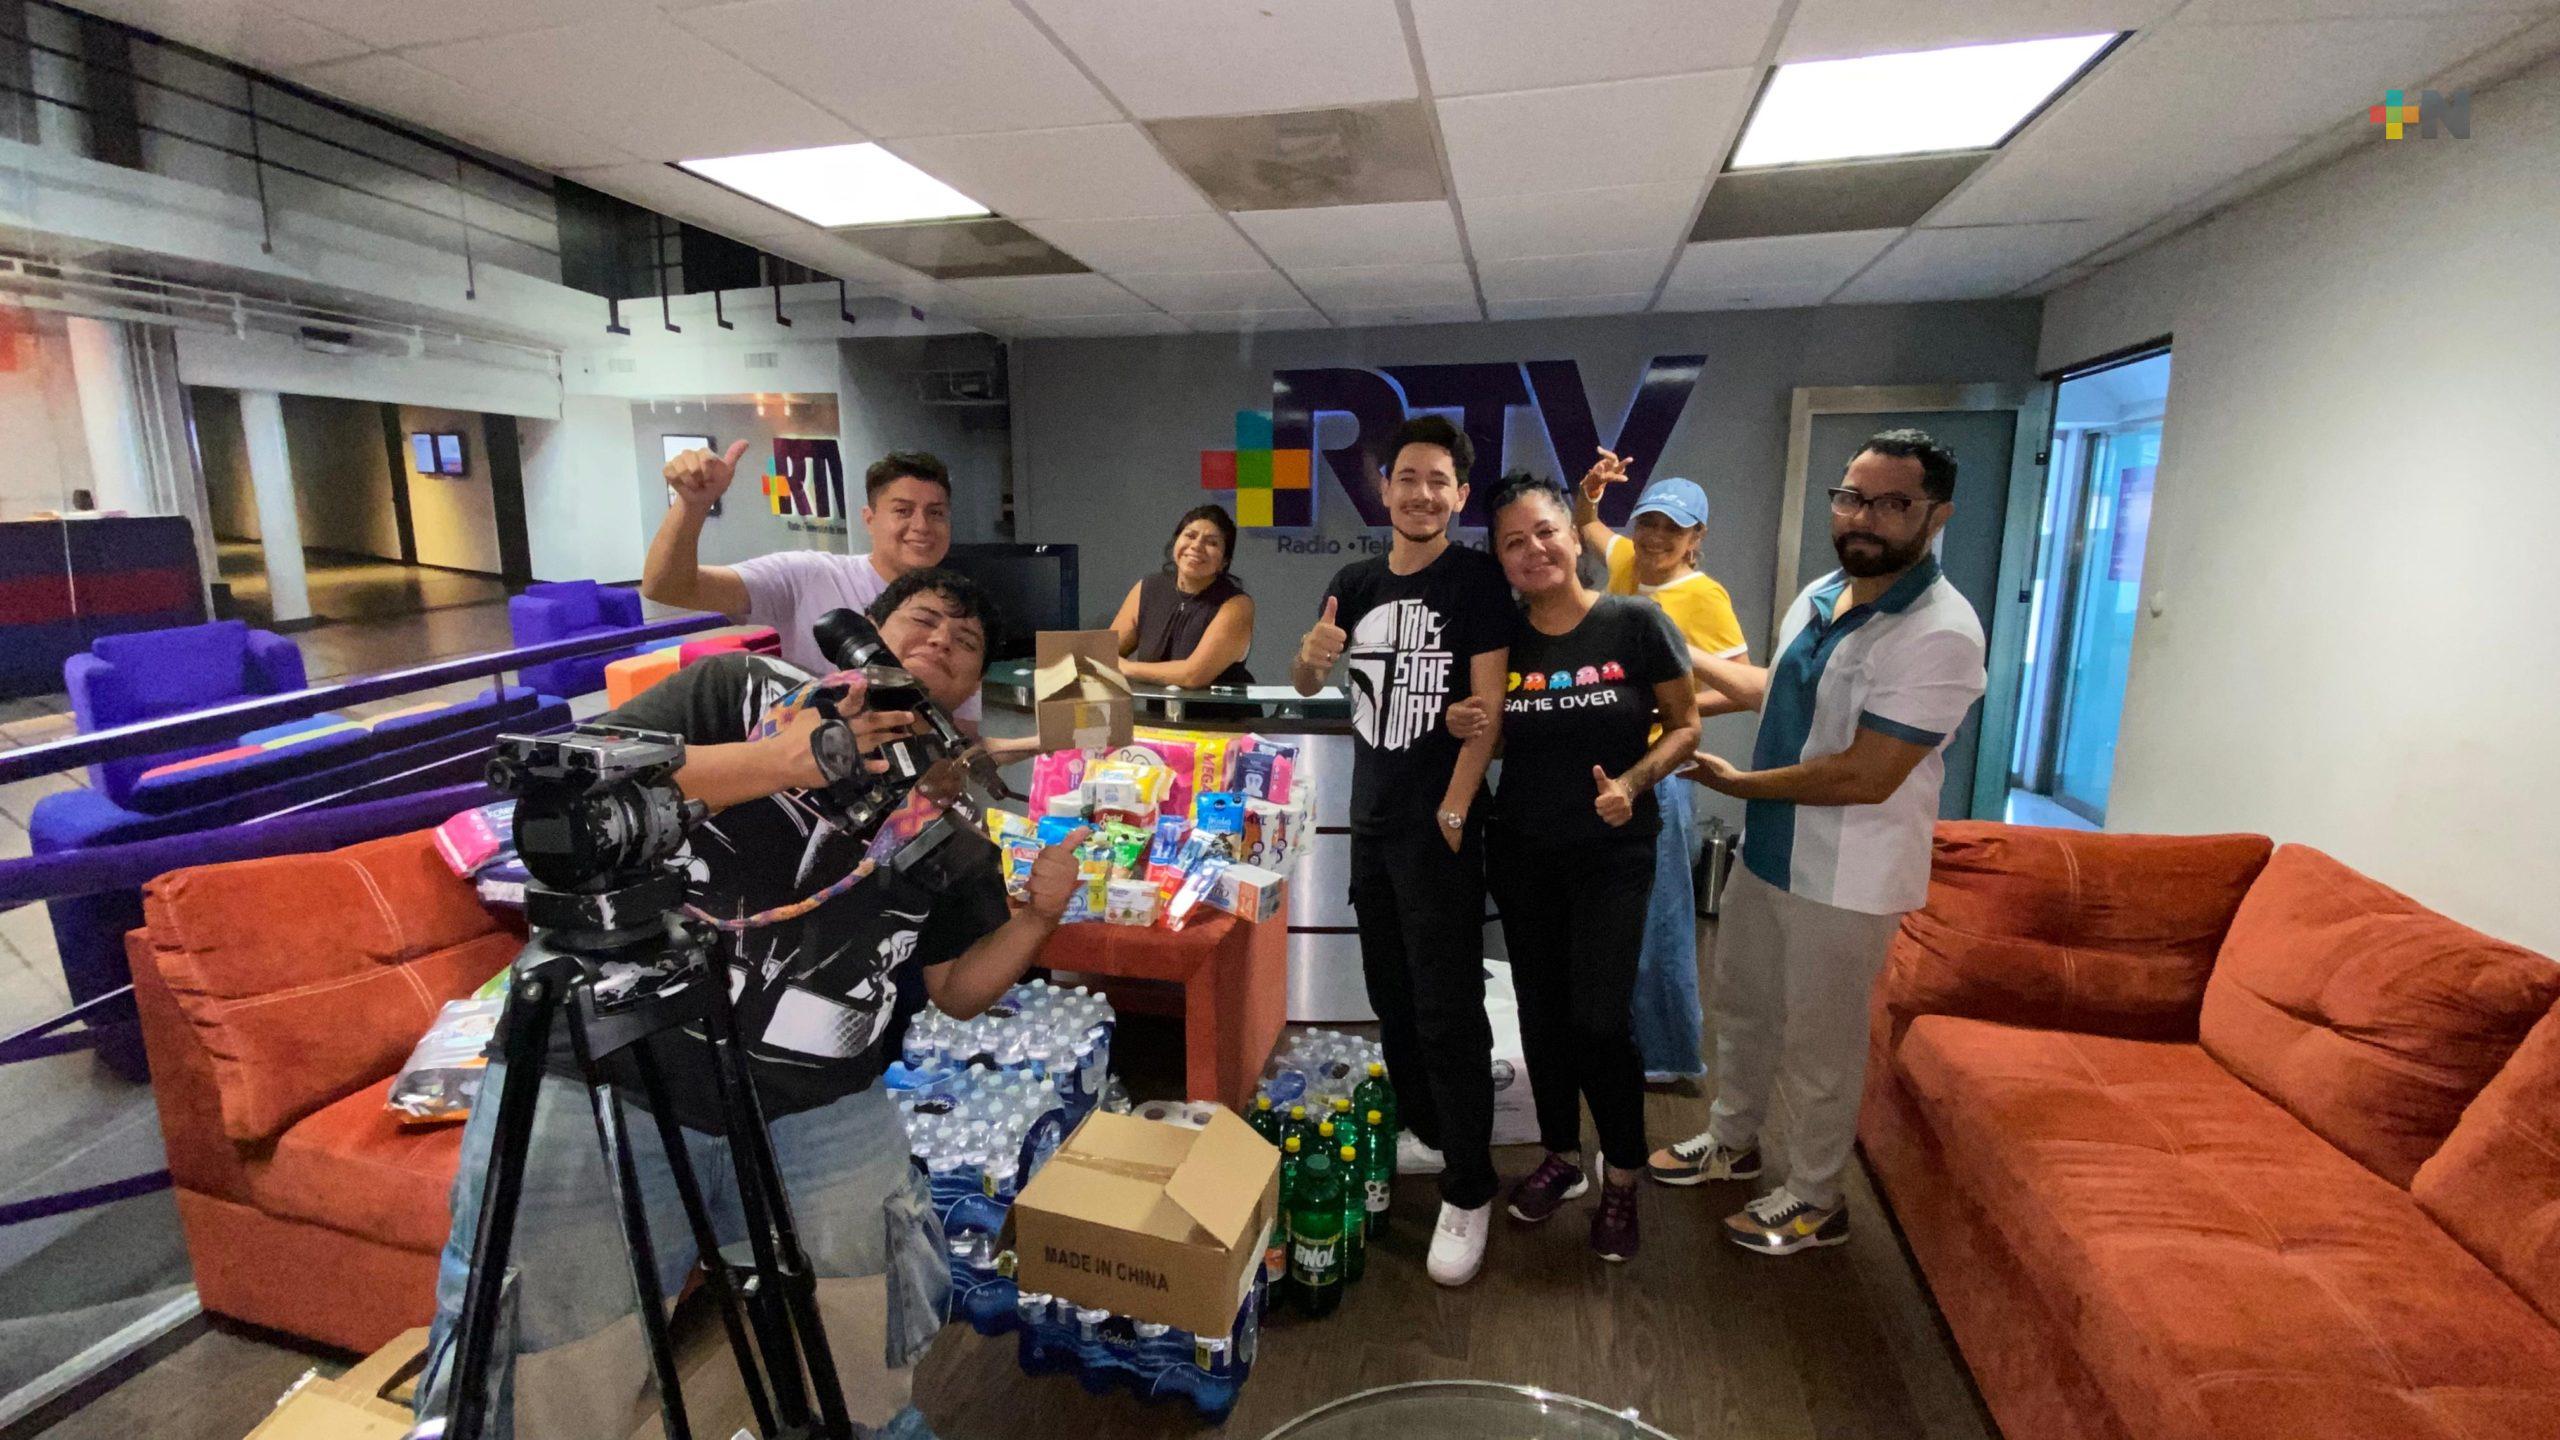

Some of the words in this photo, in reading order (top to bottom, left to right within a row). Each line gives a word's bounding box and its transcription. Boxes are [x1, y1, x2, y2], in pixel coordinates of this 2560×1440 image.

[1272, 354, 1708, 528] RTV
[1277, 535, 1341, 554] Radio
[1398, 599, 1441, 651] THIS
[1409, 651, 1453, 694] THE
[1384, 686, 1443, 752] WAY
[1560, 689, 1618, 709] OVER
[1045, 1245, 1091, 1273] MADE
[1096, 1258, 1112, 1278] IN
[1116, 1262, 1169, 1292] CHINA
